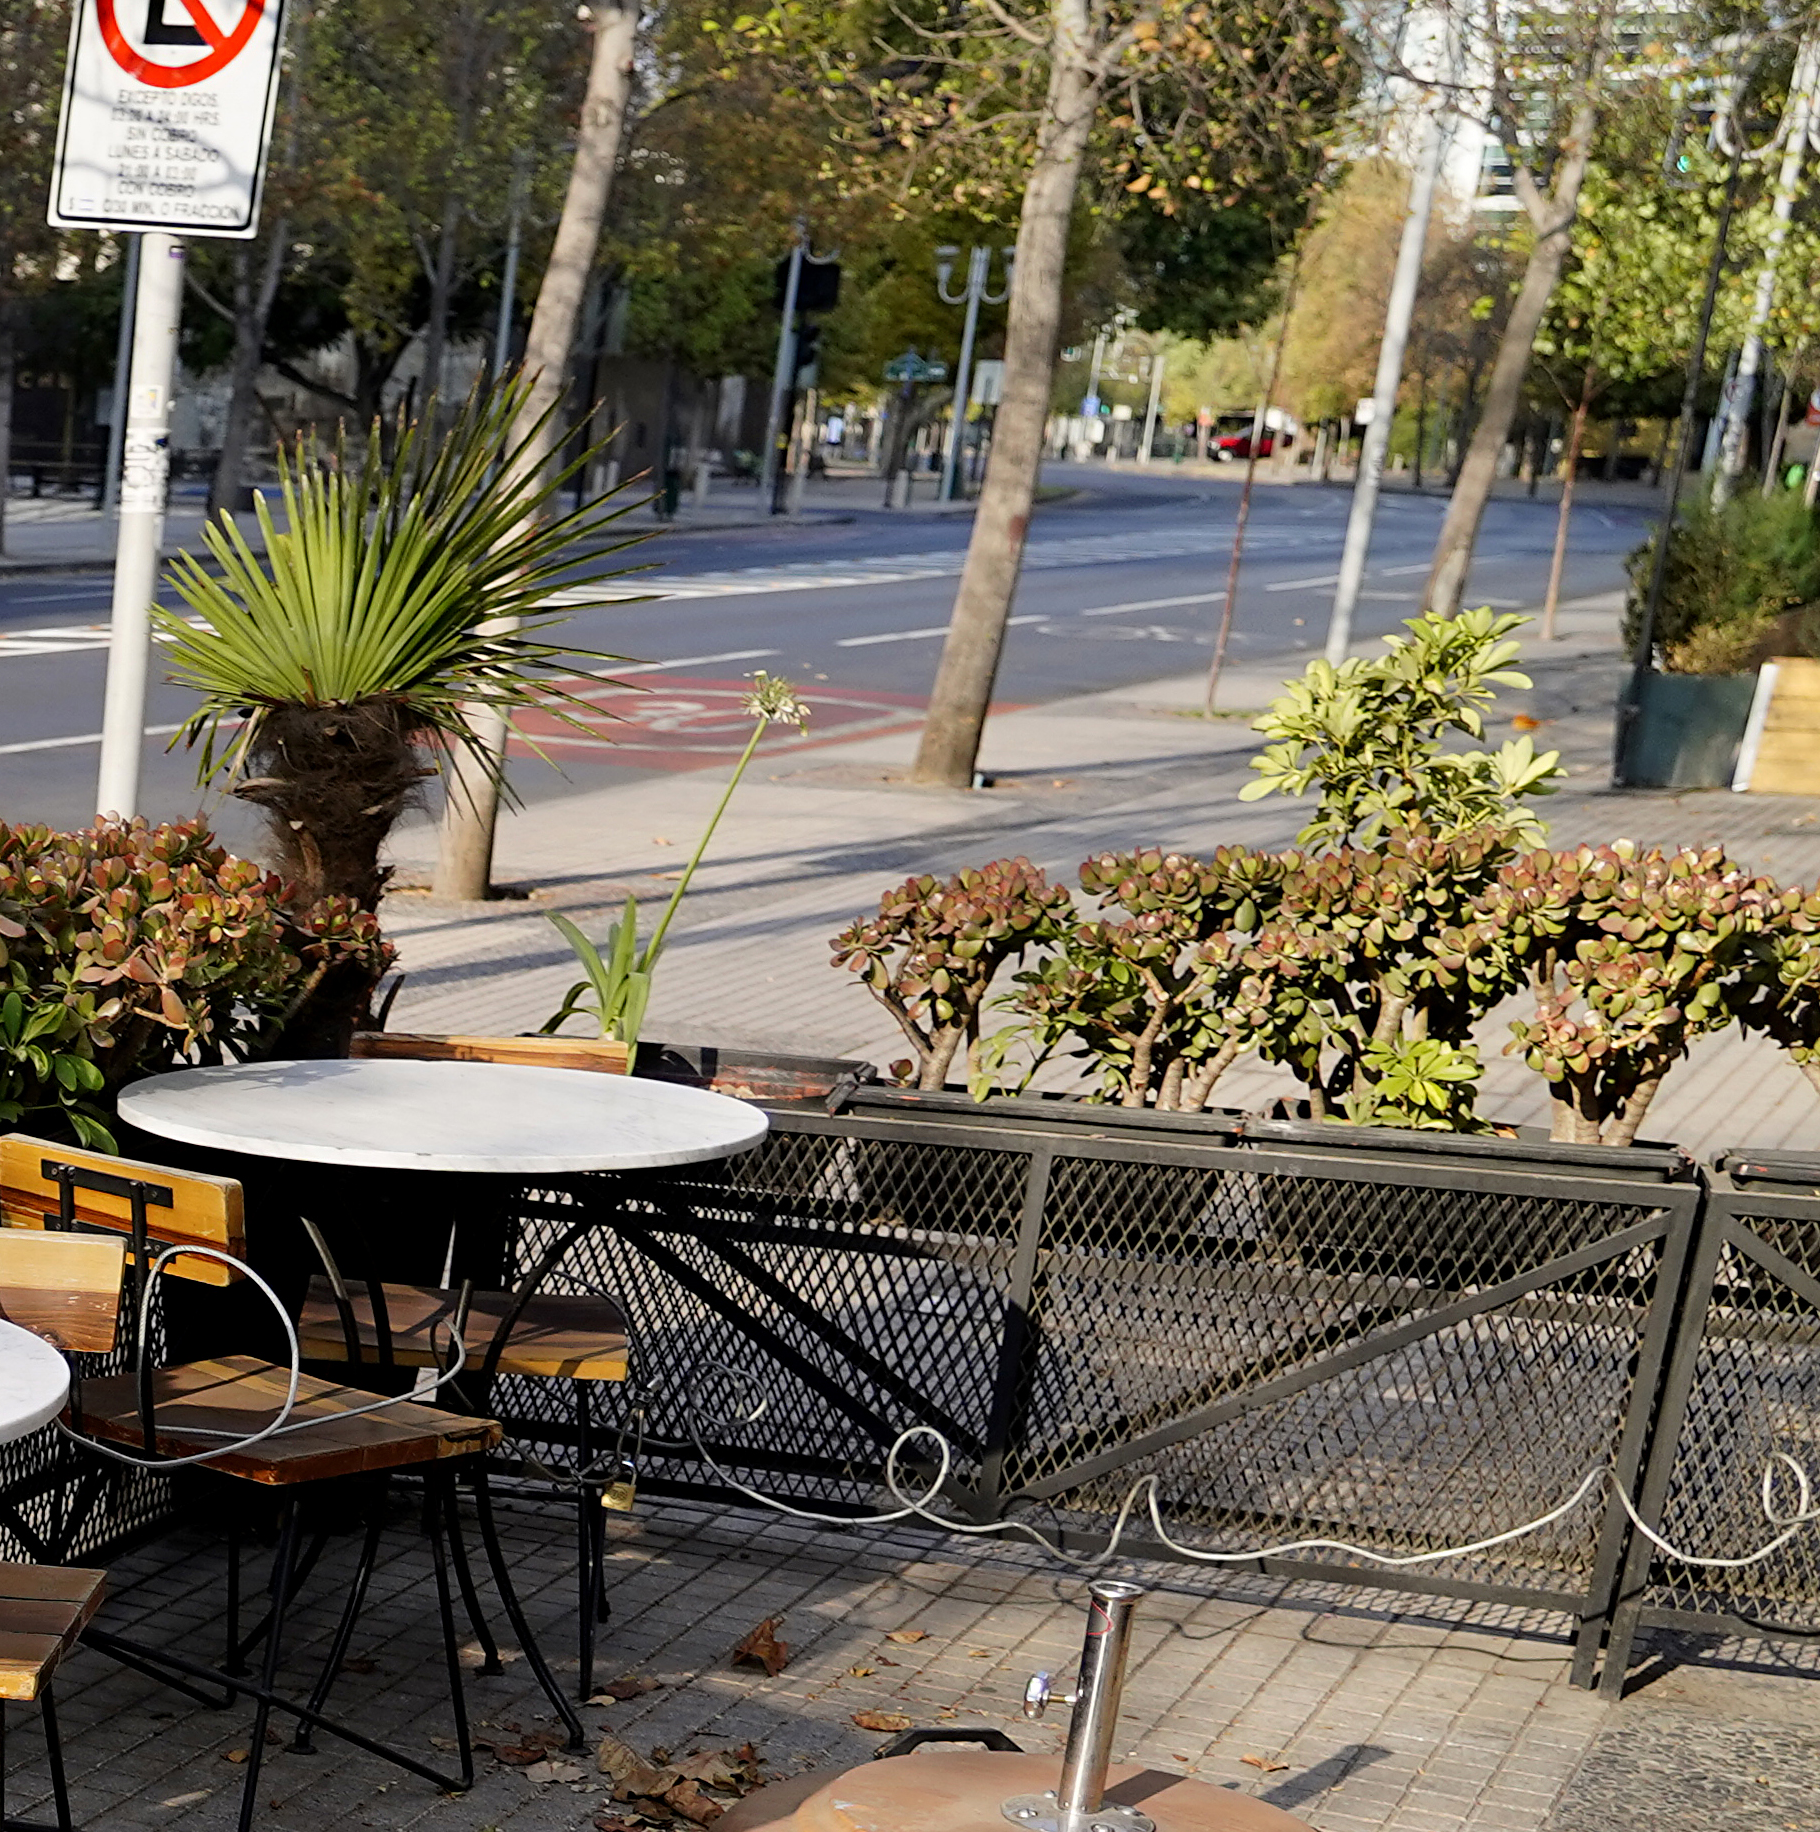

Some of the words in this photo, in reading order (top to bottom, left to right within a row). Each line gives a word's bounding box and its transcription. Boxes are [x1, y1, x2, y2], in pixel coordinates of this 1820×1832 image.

[118, 89, 177, 106] EXCEPTO
[127, 126, 147, 141] SIN
[152, 127, 199, 143] COBRO
[107, 144, 149, 160] LUNES
[118, 180, 144, 195] CON
[149, 182, 197, 198] COBRO
